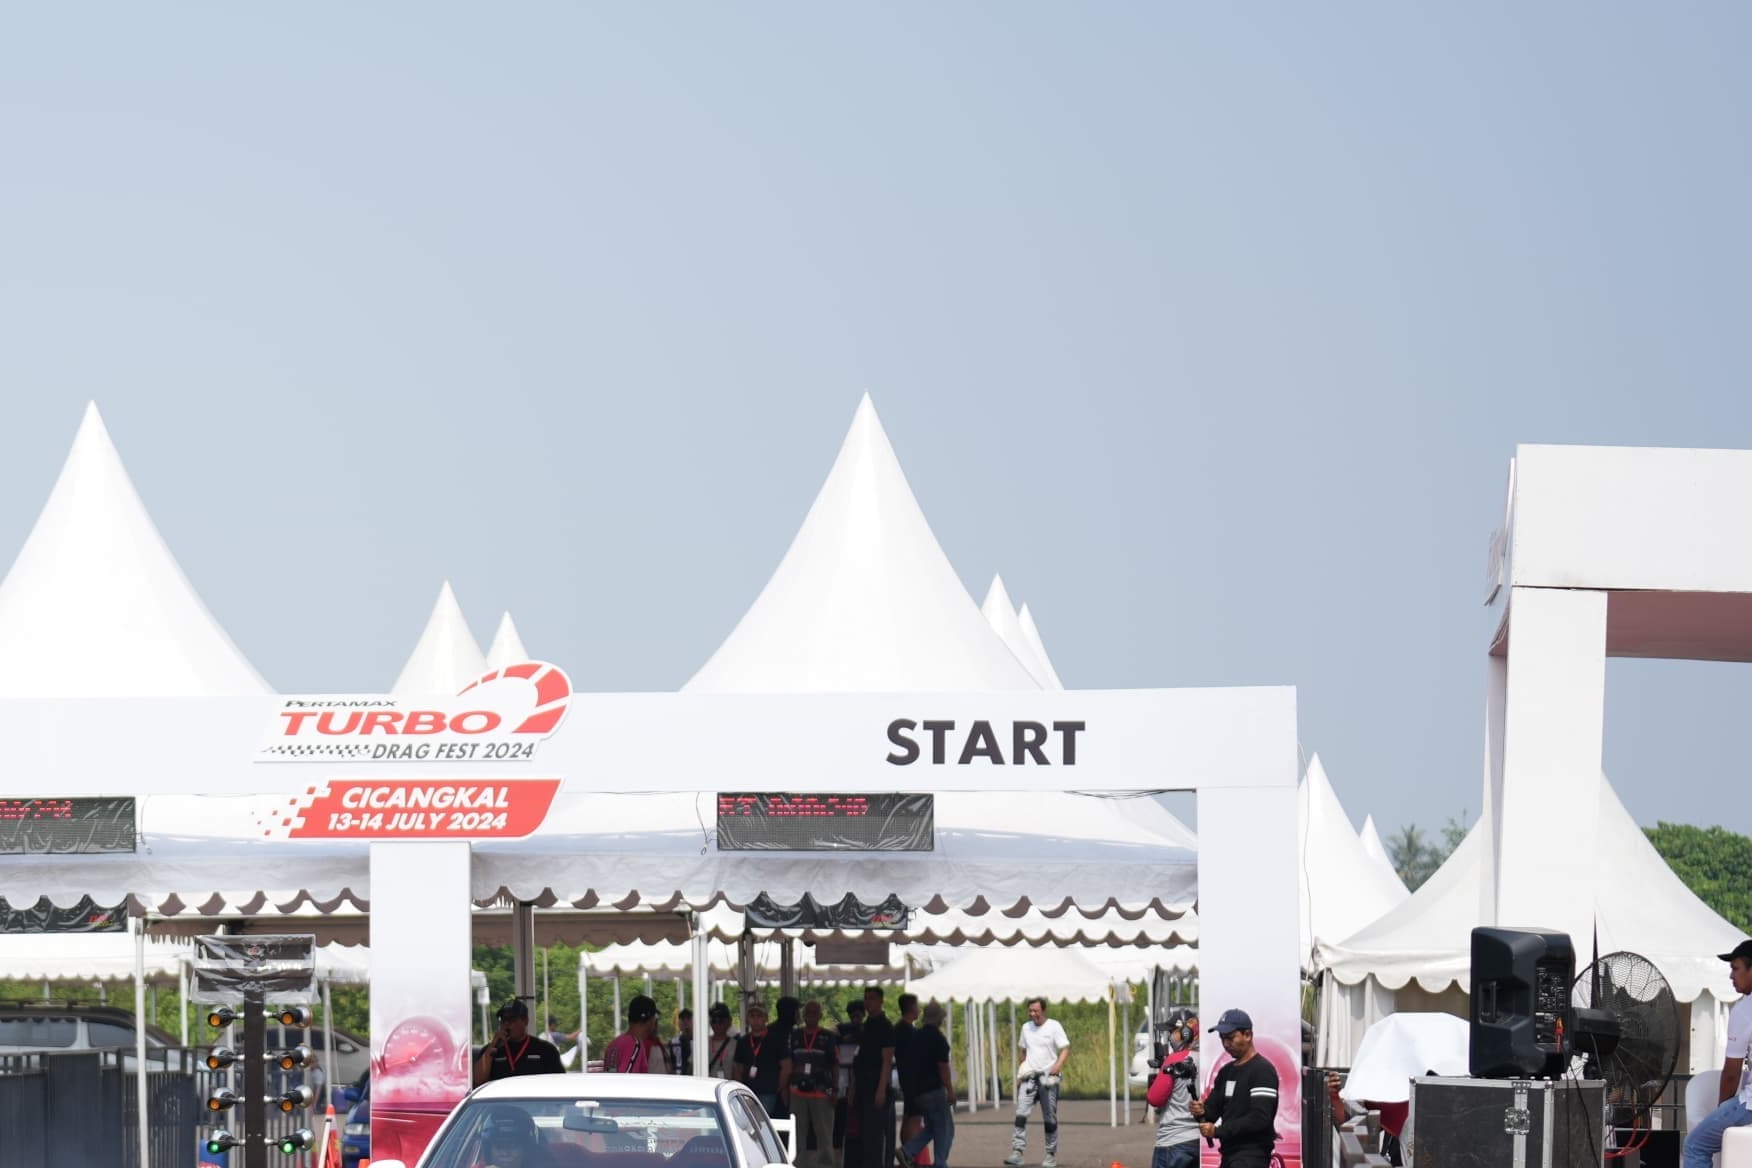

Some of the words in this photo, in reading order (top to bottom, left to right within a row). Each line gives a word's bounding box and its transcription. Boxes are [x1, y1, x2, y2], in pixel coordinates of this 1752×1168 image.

[279, 711, 502, 736] TURBO
[372, 743, 431, 760] DRAG
[435, 743, 480, 760] FEST
[485, 742, 535, 759] 2024
[885, 718, 1086, 766] START
[341, 786, 509, 809] CICANGKAL
[328, 812, 383, 831] 13-14
[385, 812, 442, 831] JULY
[448, 812, 507, 830] 2024
